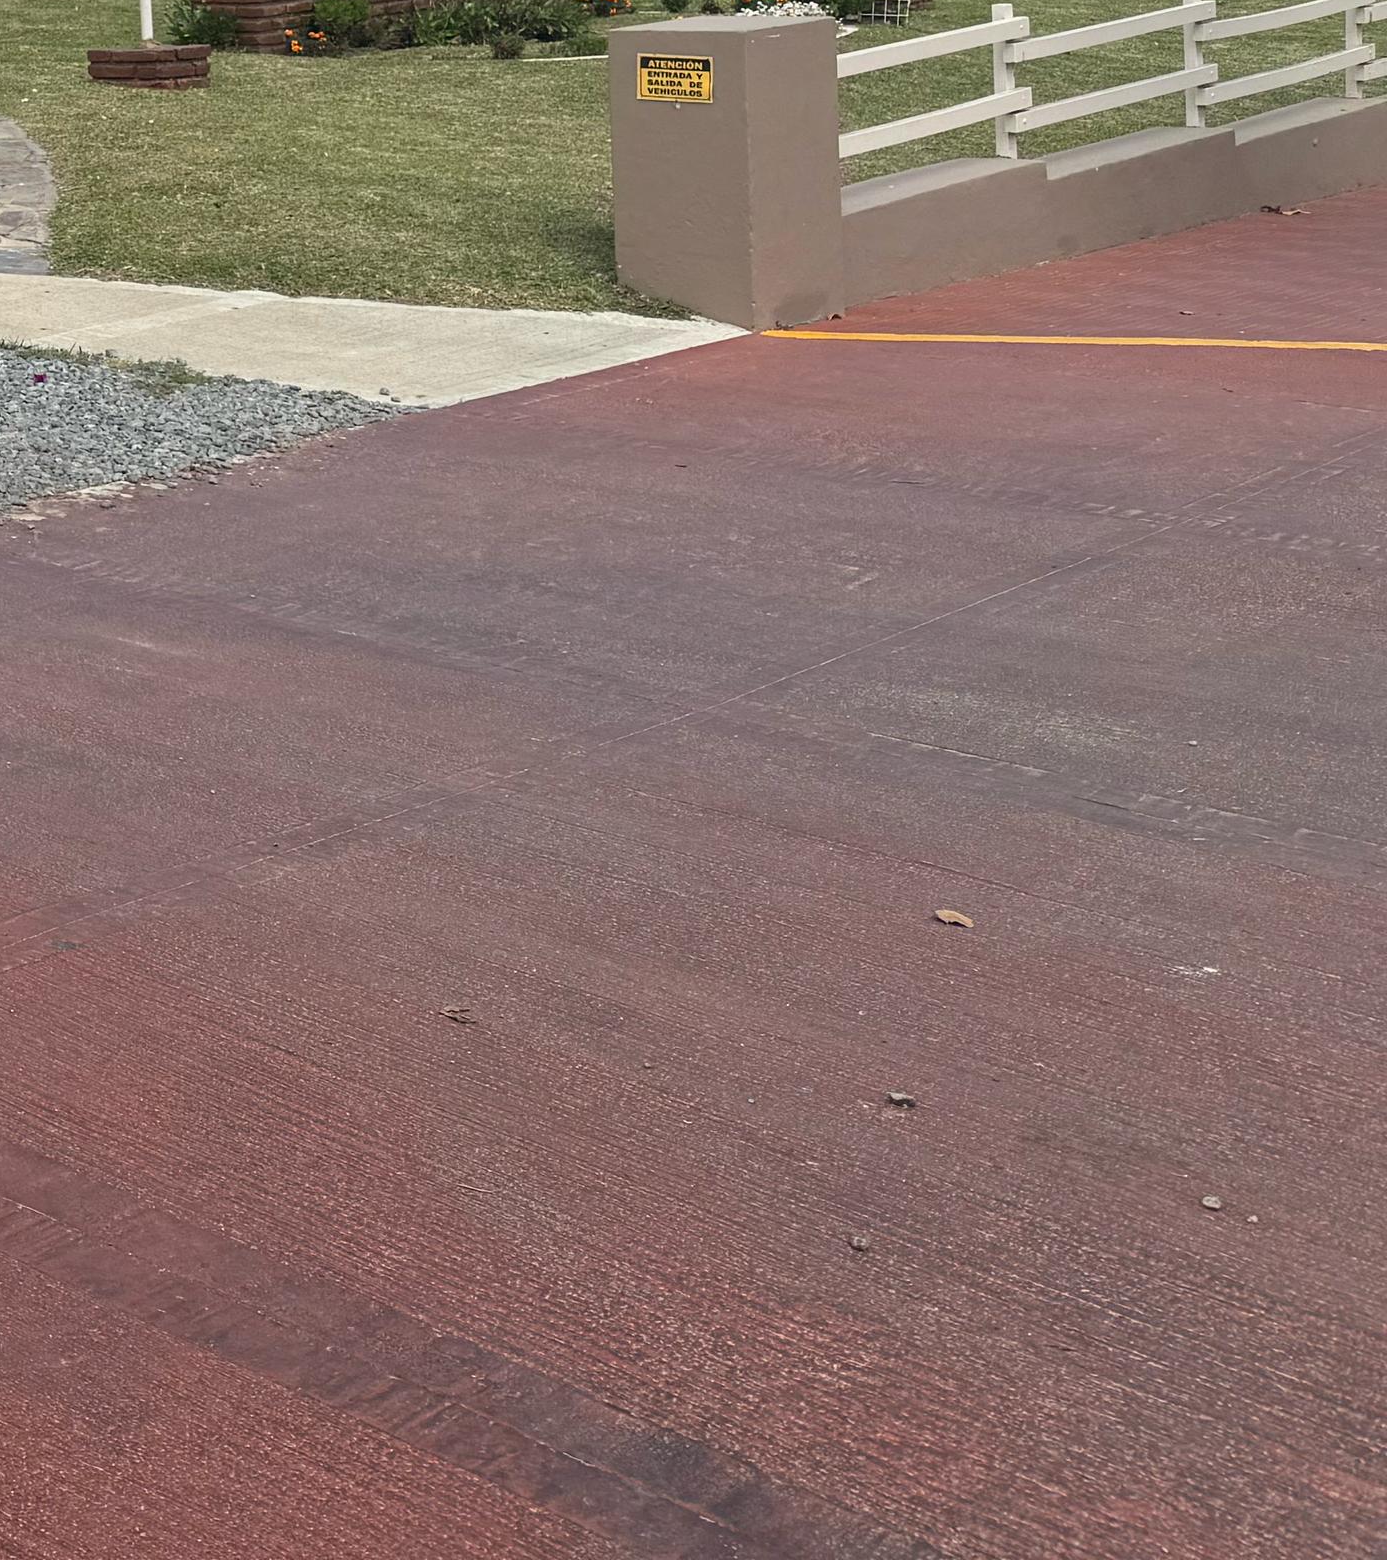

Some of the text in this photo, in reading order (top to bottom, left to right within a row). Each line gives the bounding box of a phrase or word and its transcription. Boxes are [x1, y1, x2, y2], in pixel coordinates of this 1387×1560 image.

[647, 71, 692, 79] ENTRADA
[647, 79, 682, 87] SALIDA
[647, 88, 703, 97] VEHICULOS
